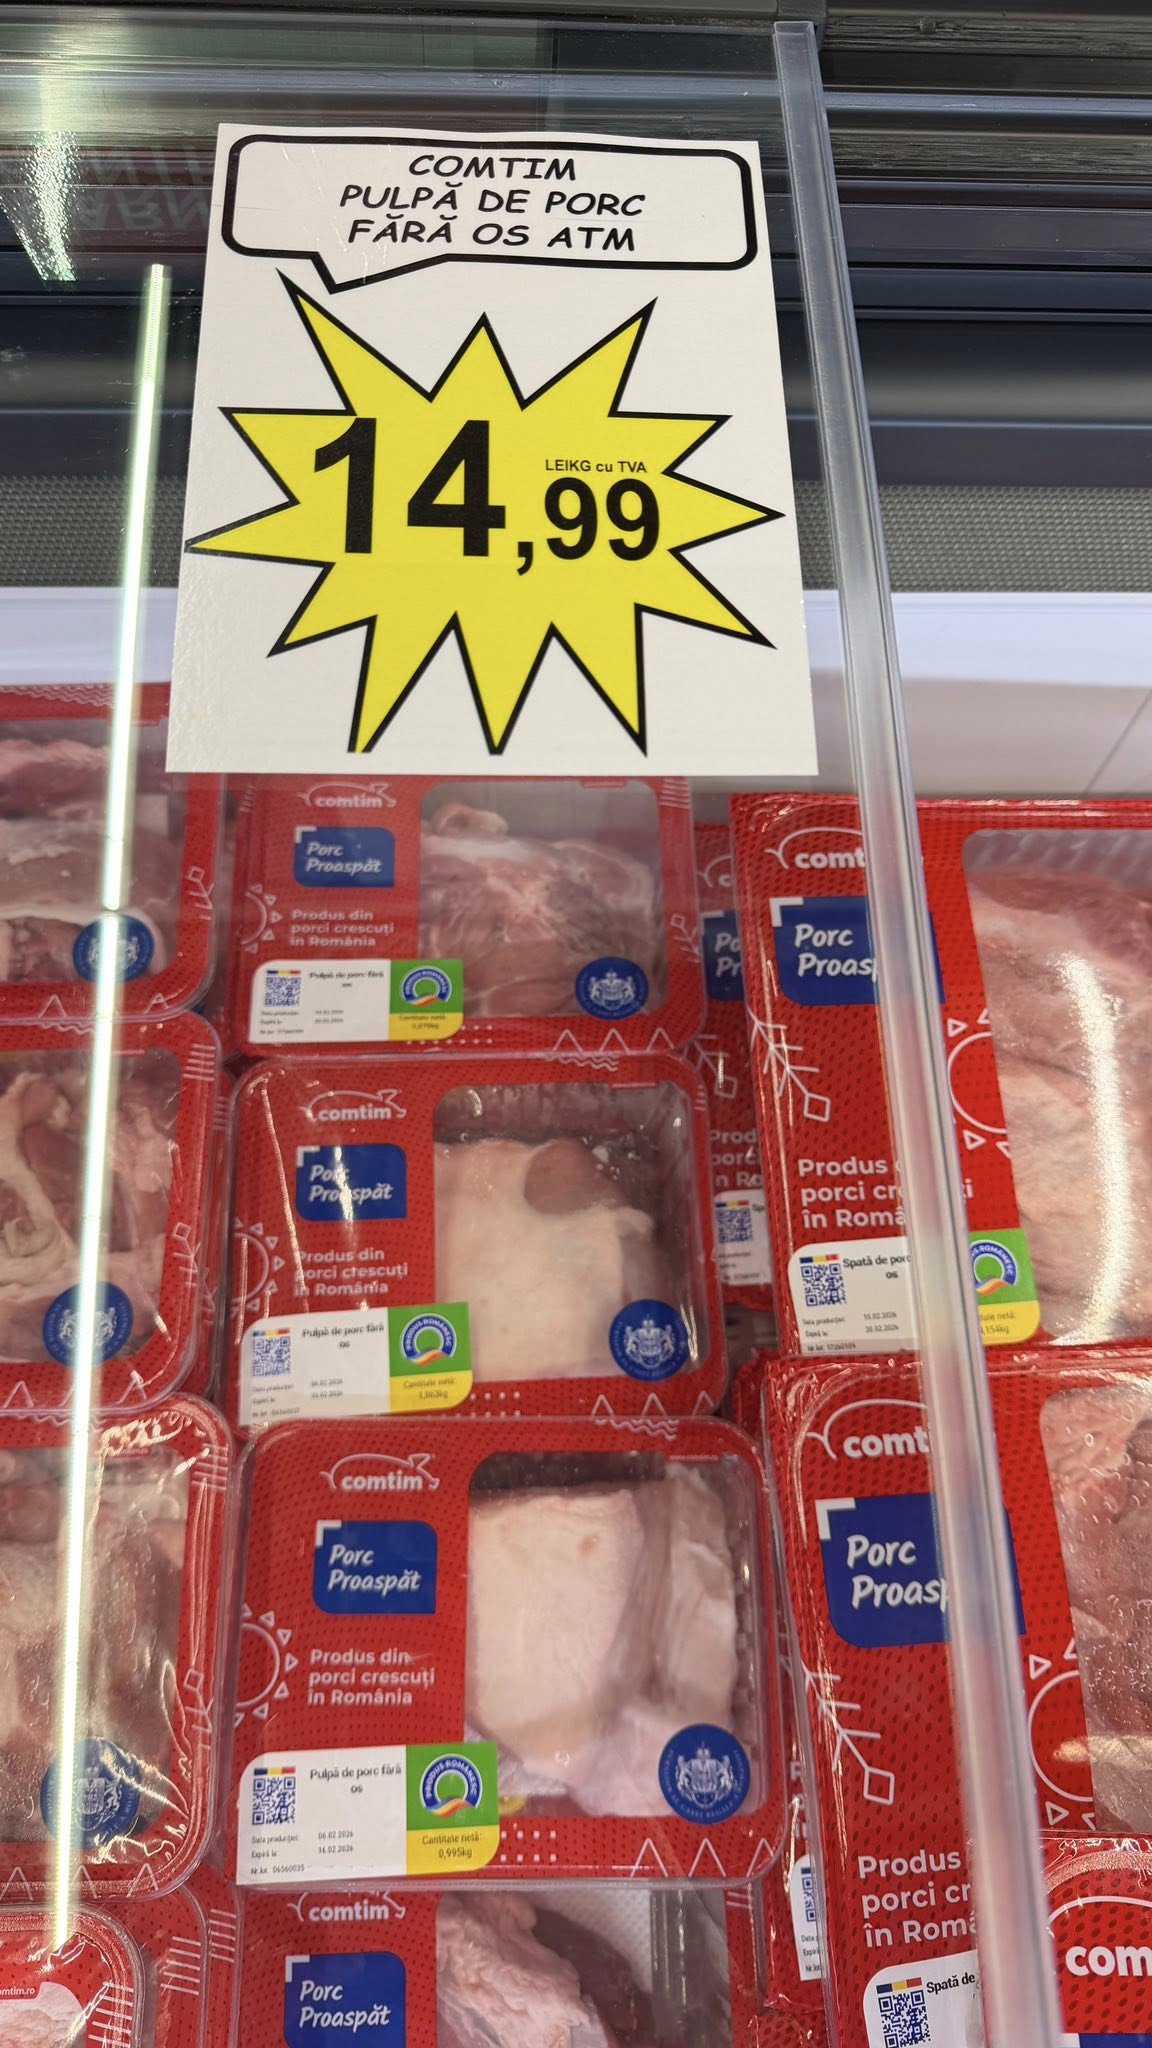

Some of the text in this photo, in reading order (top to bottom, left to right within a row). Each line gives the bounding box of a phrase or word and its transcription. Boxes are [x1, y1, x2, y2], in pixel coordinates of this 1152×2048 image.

[408, 154, 576, 181] COMTIM
[339, 181, 646, 217] PULPĂ DE PORC
[347, 214, 636, 252] FĂRĂ OS ATM
[545, 459, 648, 474] LEIKG cu TVA
[314, 417, 660, 576] 14,99
[315, 794, 383, 808] comtim
[306, 841, 344, 857] Porc
[794, 848, 866, 870] comt
[305, 857, 383, 877] Proaspăt
[291, 908, 374, 921] Produs din
[289, 922, 330, 936] porci
[794, 923, 854, 948] Porc
[309, 935, 376, 947] România
[715, 932, 741, 953] Po
[798, 951, 879, 984] Proas
[318, 1103, 392, 1121] comtim
[709, 1128, 757, 1145] Prod
[798, 1156, 888, 1178] Produs
[308, 1182, 394, 1205] Prospăt
[801, 1179, 865, 1206] porci
[803, 1203, 906, 1229] în Româ
[297, 1247, 385, 1263] Produs din
[843, 1255, 912, 1270] Spată de porc
[295, 1265, 337, 1280] porci
[885, 1271, 899, 1279] os
[315, 1280, 389, 1296] România
[332, 1327, 343, 1336] de
[843, 1426, 930, 1459] comt
[341, 1469, 423, 1491] comtim
[328, 1544, 374, 1566] Porc
[846, 1534, 917, 1567] Porc
[327, 1568, 421, 1597] Proaspăt
[851, 1573, 948, 1612] Proas
[309, 1647, 411, 1665] Produs din
[308, 1667, 435, 1688] porci crescuți
[307, 1686, 413, 1705] în România
[310, 1763, 402, 1781] Pulpă de porc fără
[438, 1847, 473, 1859] 0,995kg
[858, 1849, 961, 1879] Produs
[308, 1899, 390, 1921] comtim
[861, 1881, 936, 1918] porci
[864, 1923, 893, 1948] în
[1065, 1945, 1152, 1977] com
[300, 1979, 344, 2001] Porc
[926, 1974, 959, 1995] Spată
[961, 1971, 976, 1986] de
[299, 2003, 392, 2033] Proaspăt
